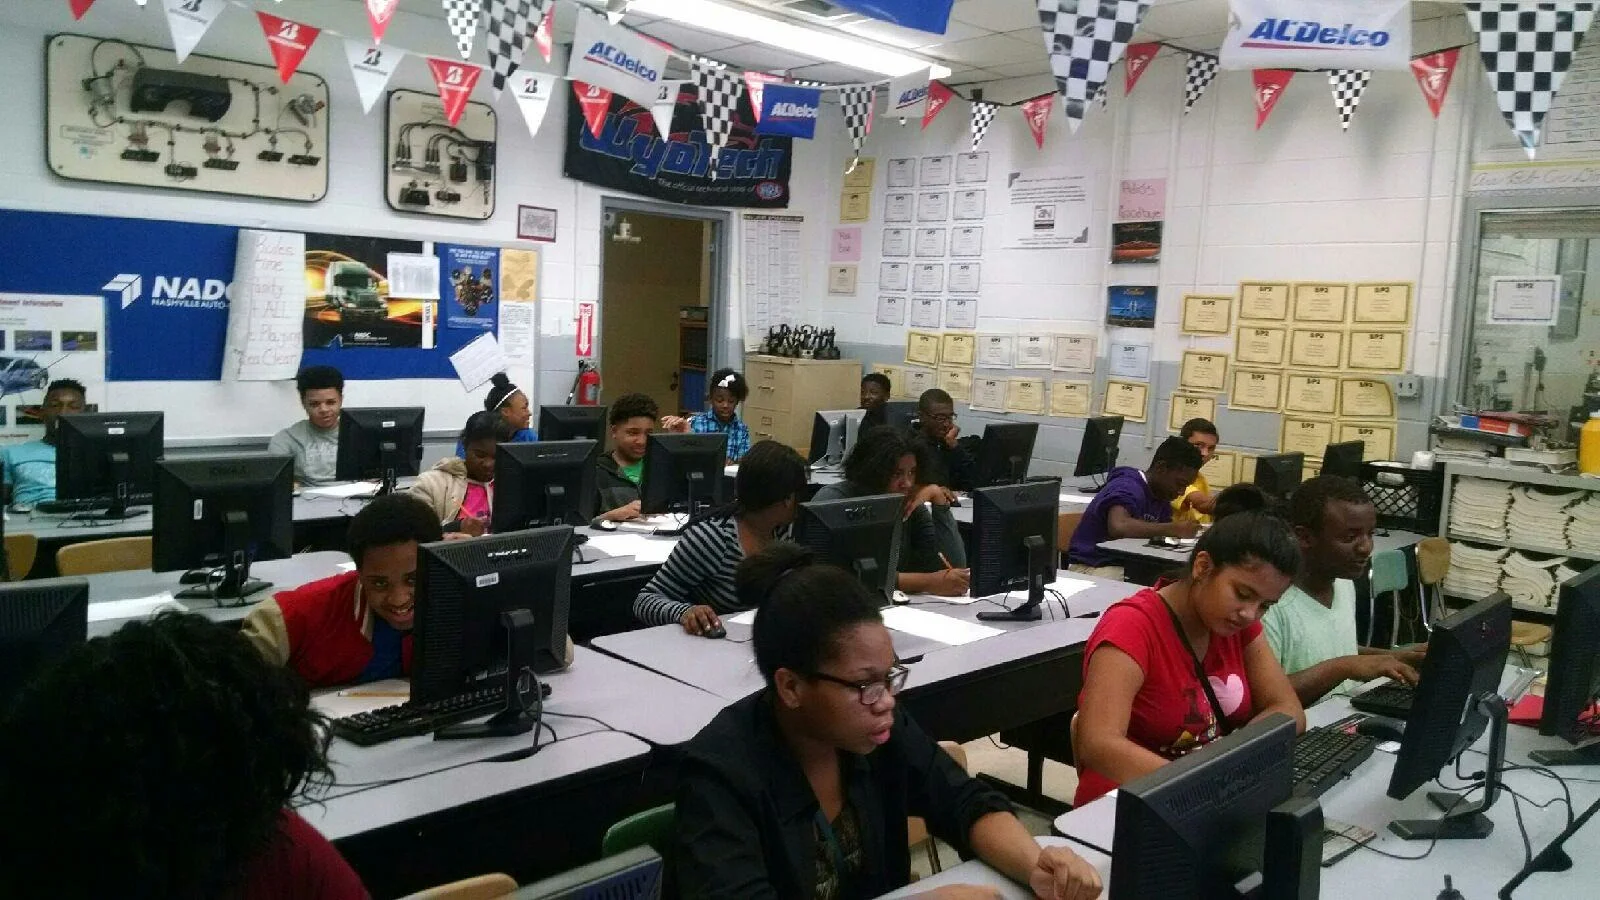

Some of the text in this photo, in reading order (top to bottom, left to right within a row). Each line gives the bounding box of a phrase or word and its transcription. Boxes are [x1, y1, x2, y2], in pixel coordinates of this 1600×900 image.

[1249, 18, 1390, 47] ACDelco
[587, 42, 658, 82] ACDelco
[152, 299, 200, 308] NASHVILLE
